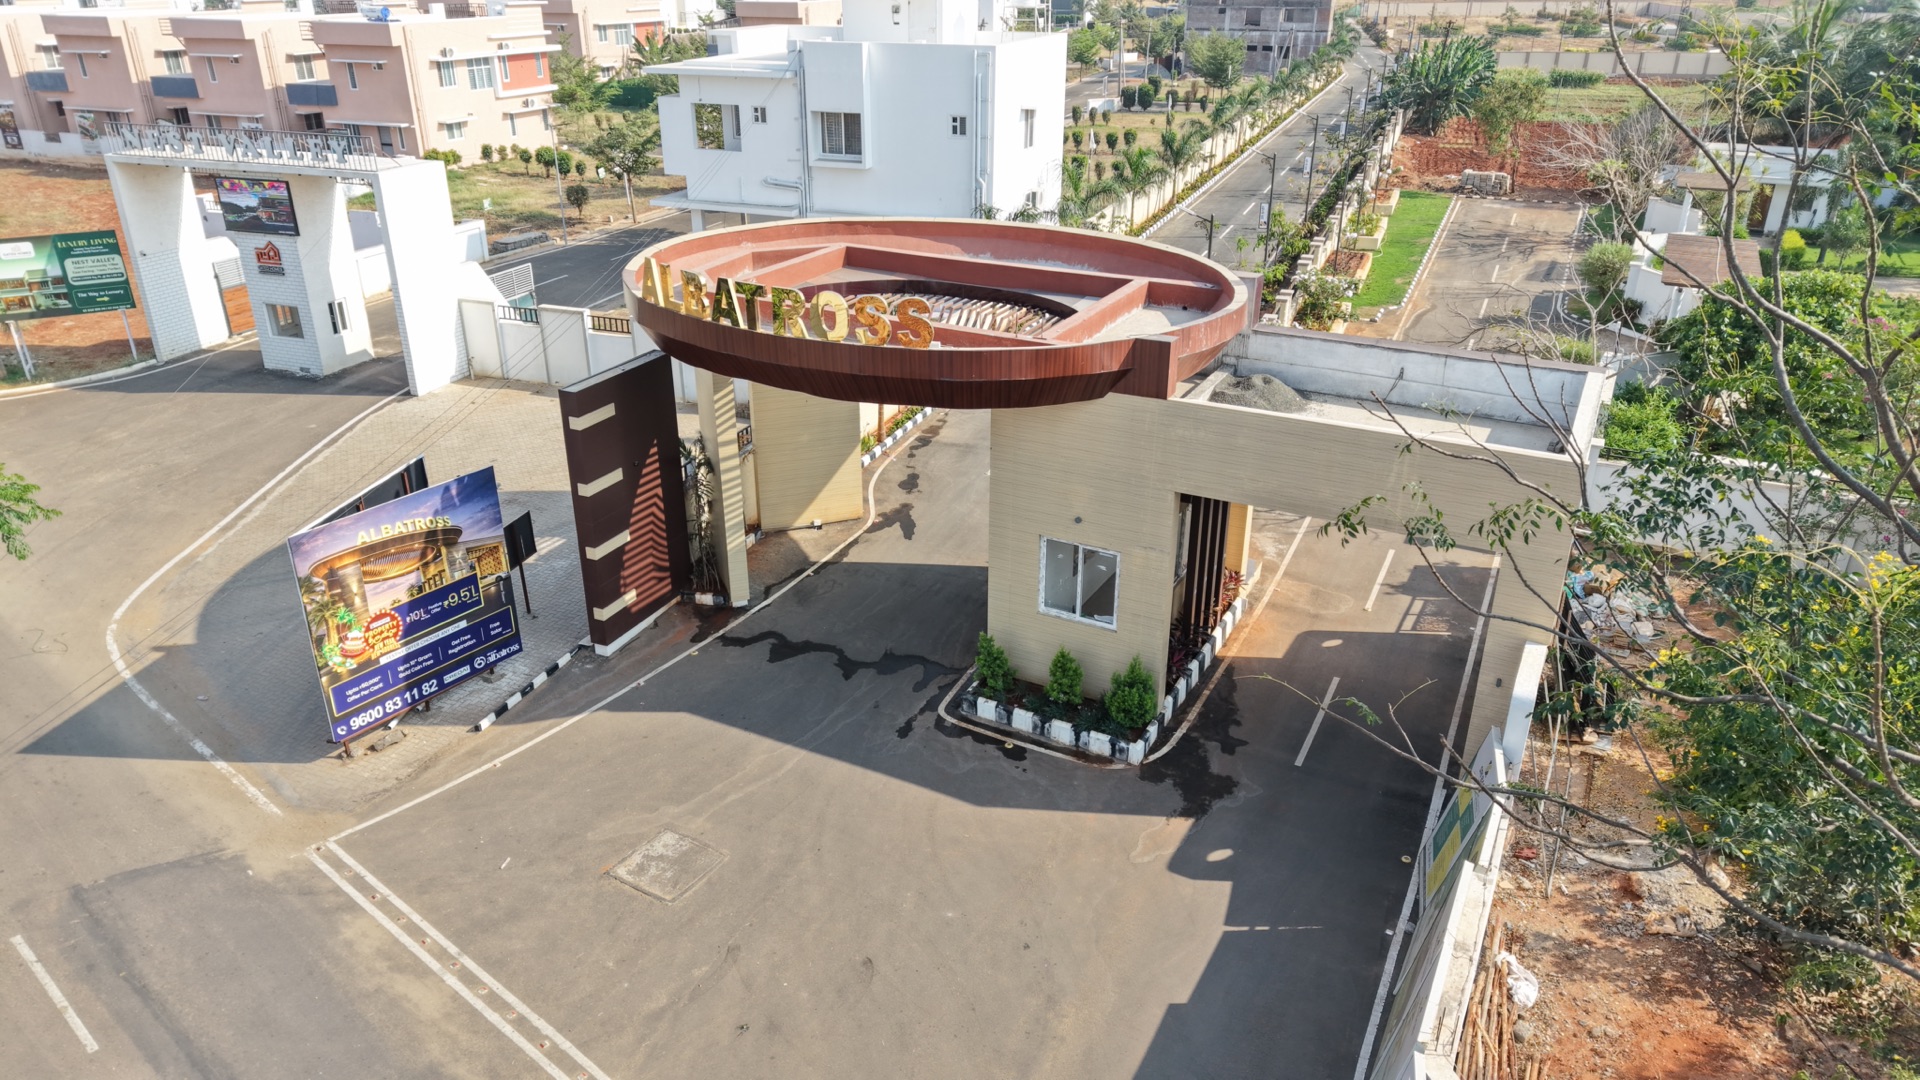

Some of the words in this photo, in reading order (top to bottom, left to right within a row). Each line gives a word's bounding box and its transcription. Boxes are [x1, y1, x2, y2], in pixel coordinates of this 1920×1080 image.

[121, 127, 204, 154] NEST
[217, 132, 348, 165] VALLEY
[57, 239, 88, 248] LUXURY
[90, 237, 117, 245] LIVING
[91, 256, 116, 264] VALLEY
[642, 255, 935, 350] ALBATROSS
[356, 515, 452, 545] ALBATROSS
[364, 620, 397, 638] PROPERTY
[440, 628, 450, 637] ANY
[450, 624, 461, 632] ONE
[448, 638, 477, 655] Registration
[486, 642, 520, 664] albatross
[410, 664, 423, 673] Coin
[422, 659, 434, 668] Free
[444, 666, 469, 682] CREDAI
[360, 689, 370, 697] Per
[350, 705, 383, 730] 9600
[385, 696, 402, 713] 83
[404, 687, 419, 703] 11
[421, 679, 439, 695] 82
